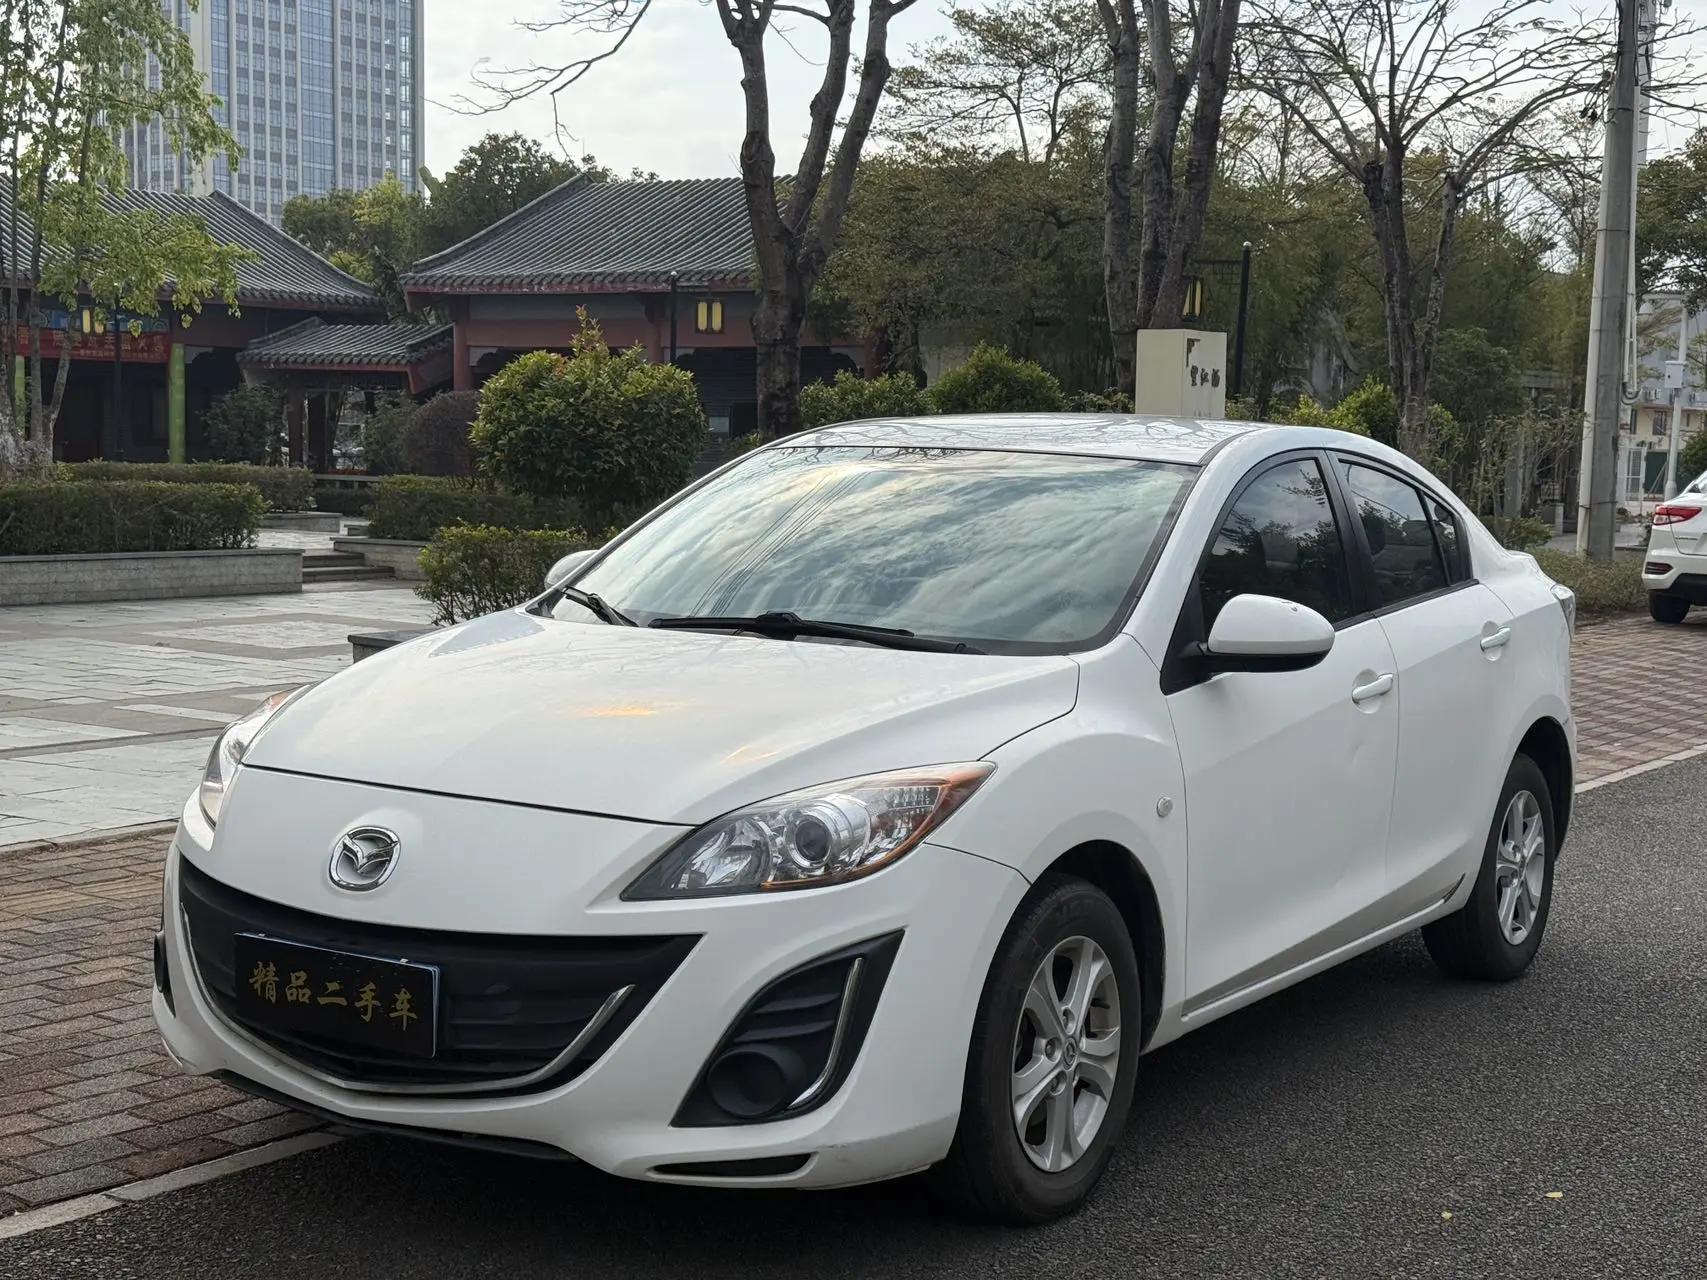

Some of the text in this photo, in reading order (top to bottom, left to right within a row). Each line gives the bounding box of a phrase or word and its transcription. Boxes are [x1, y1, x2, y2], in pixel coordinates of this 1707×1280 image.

[249, 961, 418, 1031] 精品二手车
